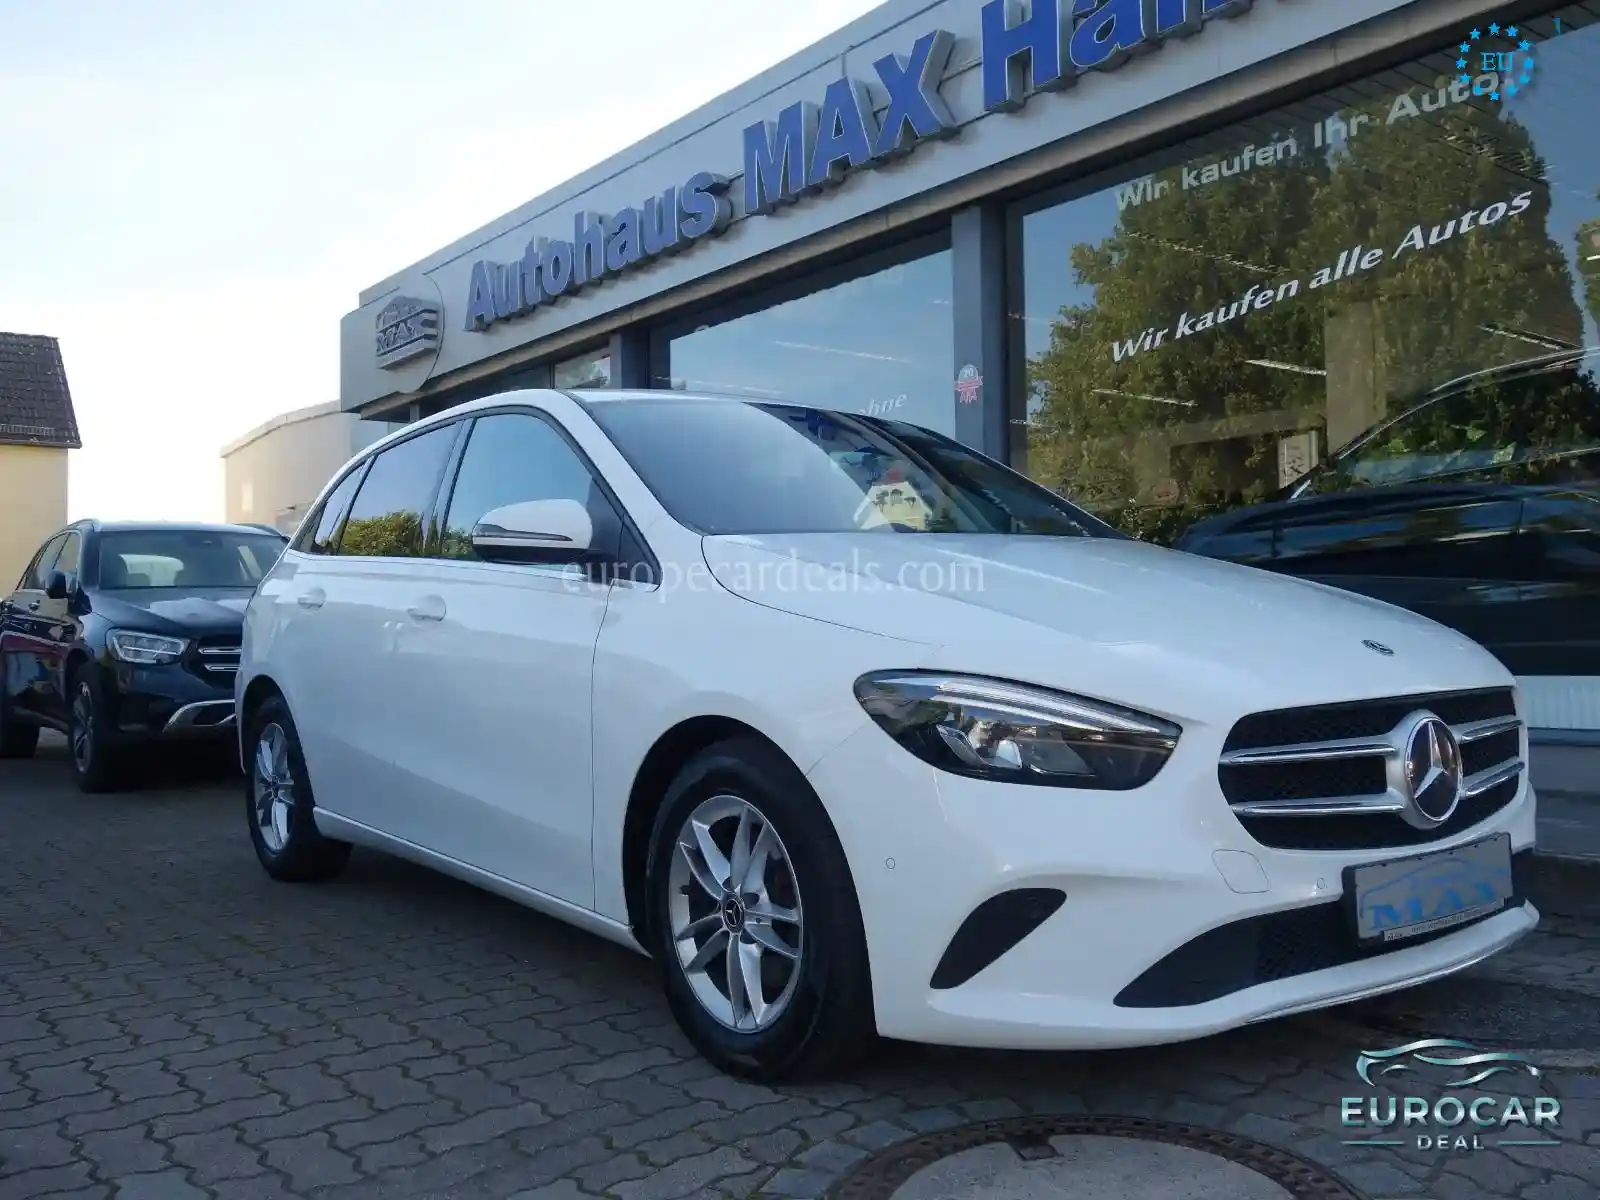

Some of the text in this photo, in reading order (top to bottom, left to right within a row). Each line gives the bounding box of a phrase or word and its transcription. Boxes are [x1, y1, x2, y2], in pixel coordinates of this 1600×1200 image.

[465, 171, 731, 331] Autohaus
[744, 30, 955, 215] MAX
[1116, 176, 1168, 210] Wir
[1182, 137, 1298, 190] kaufen
[1314, 112, 1369, 148] Ihr
[1111, 190, 1533, 363] Wir kaufen alle Autos
